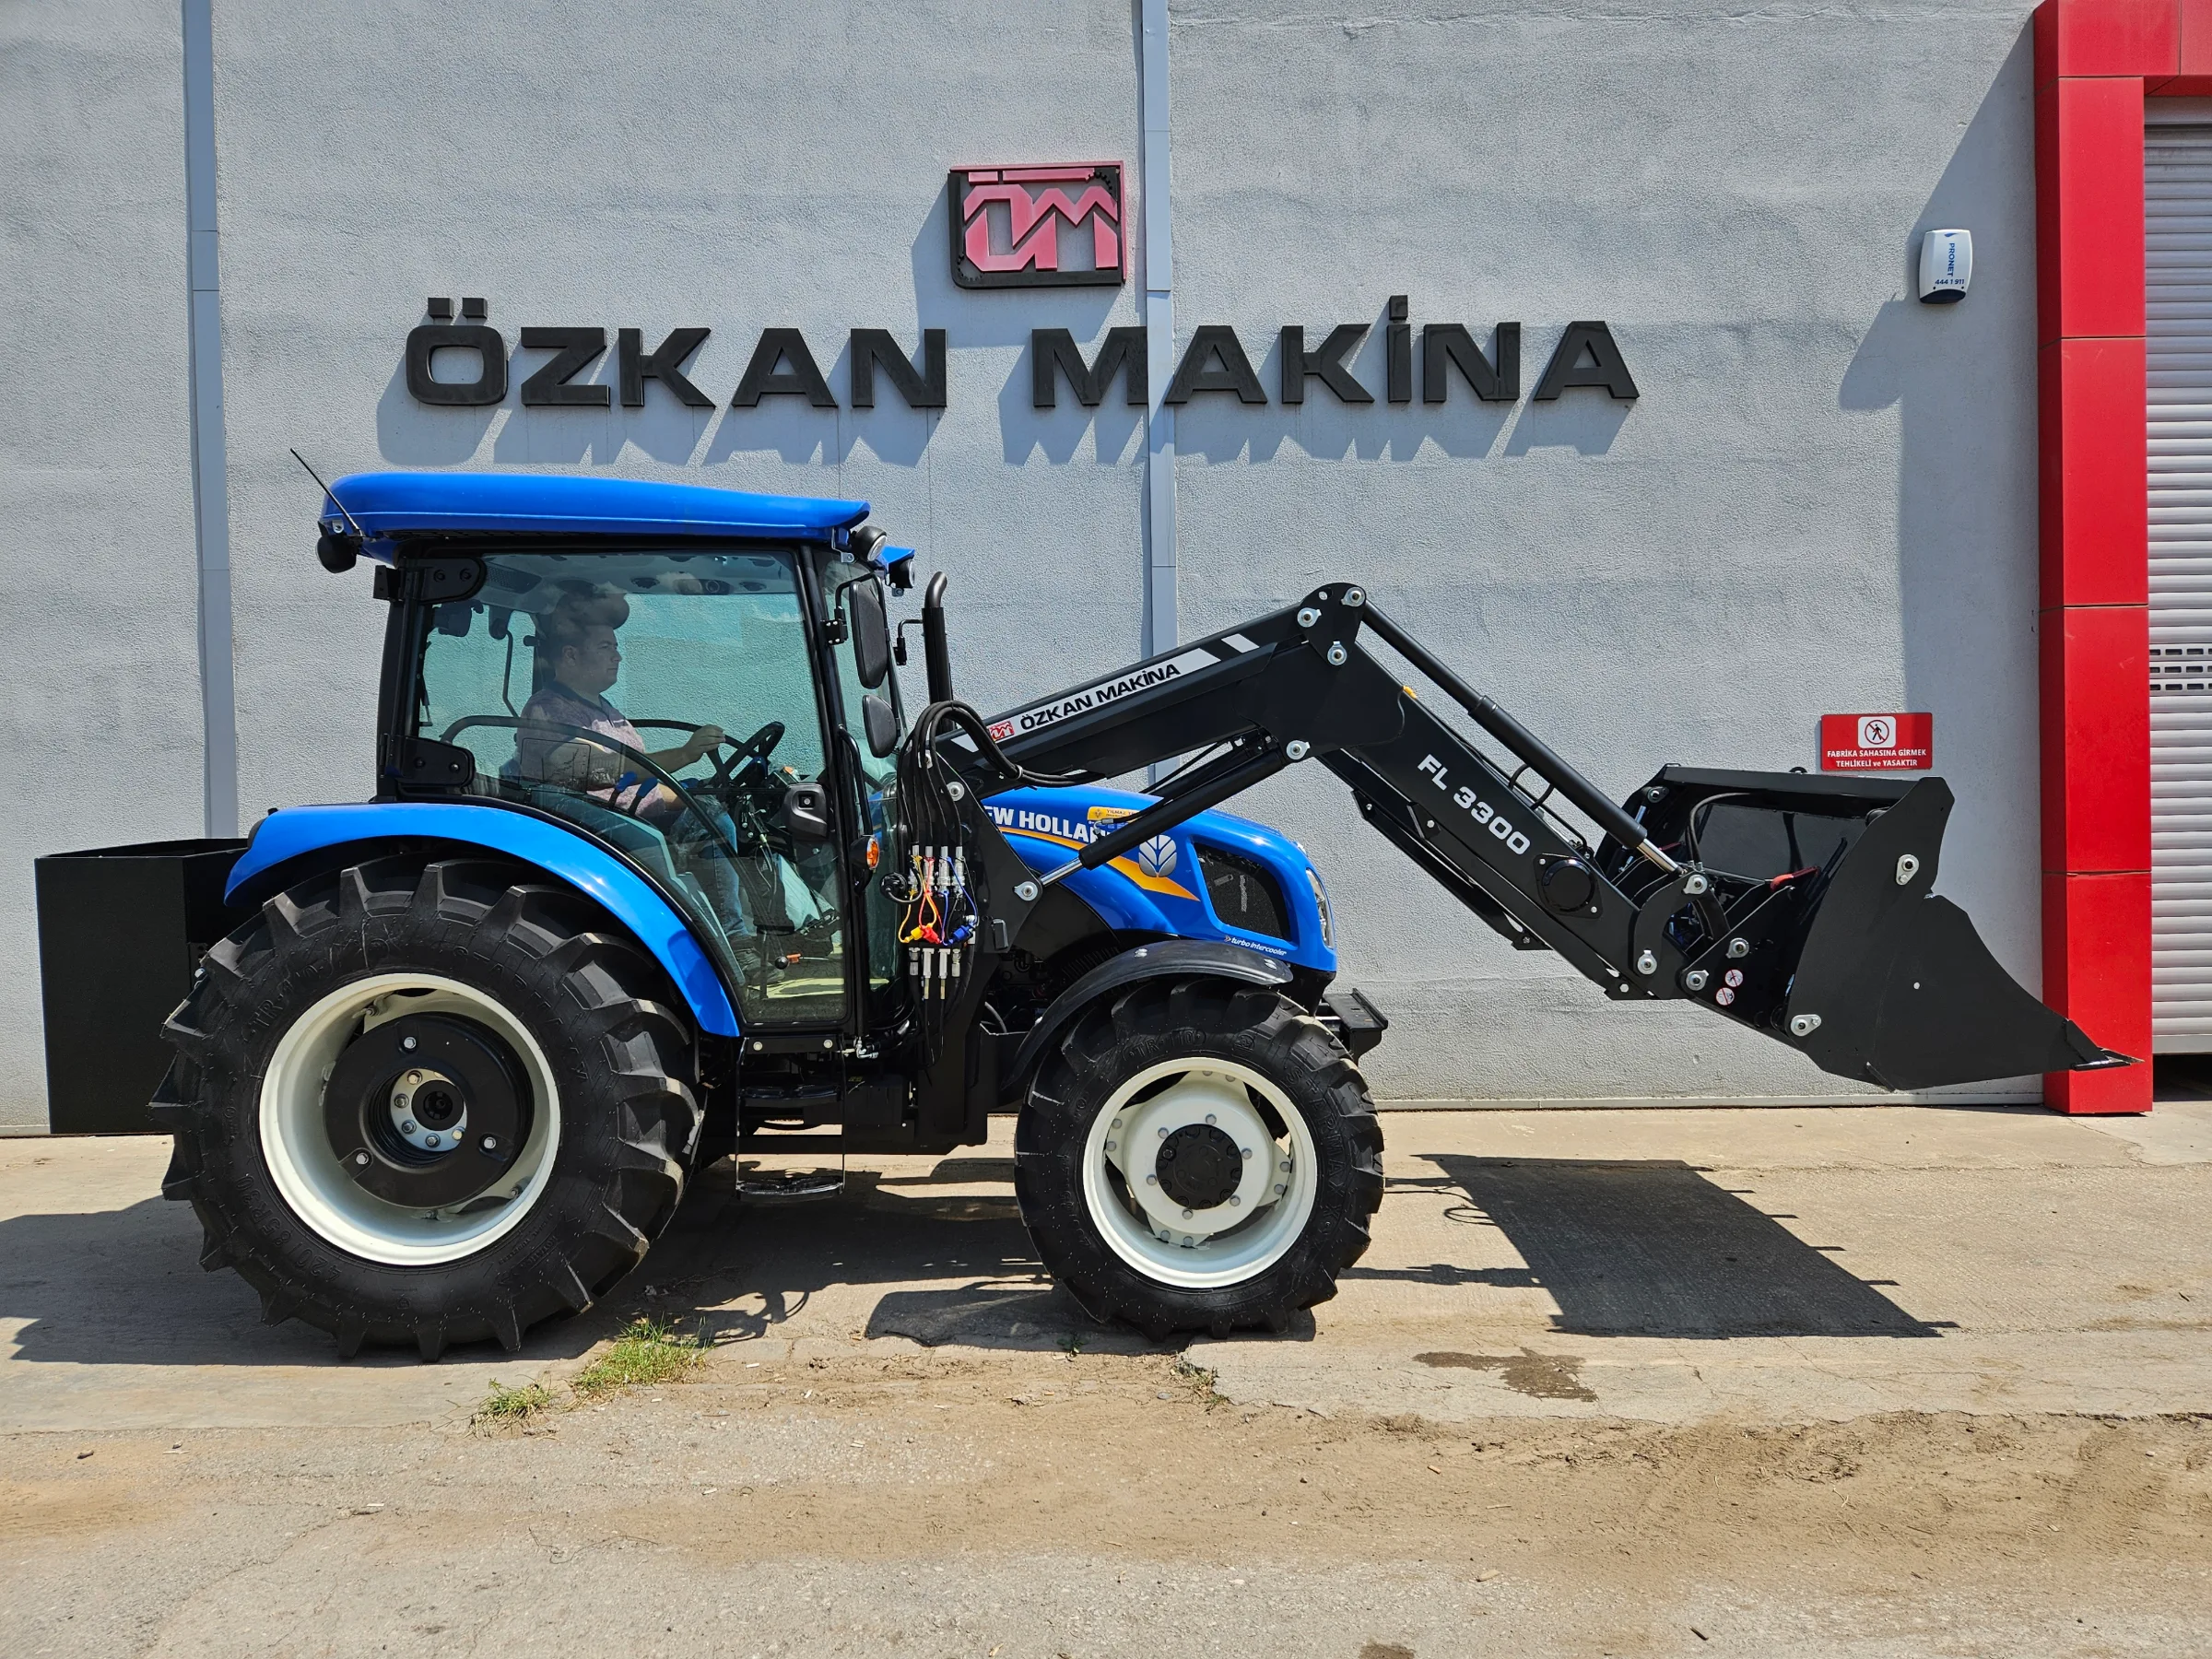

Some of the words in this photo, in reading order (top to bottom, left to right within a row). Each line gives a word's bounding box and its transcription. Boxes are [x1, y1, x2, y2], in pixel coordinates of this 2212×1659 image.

[406, 297, 947, 407] ÖZKAN
[1031, 294, 1640, 406] MAKİNA
[1020, 694, 1092, 731] ÖZKAN
[1096, 664, 1181, 703] MAKİNA
[1827, 748, 1857, 758] FABRİKA
[1898, 748, 1926, 757] GİRMEK
[1019, 810, 1111, 843] HOLLAN
[1418, 754, 1448, 791] FL
[1453, 786, 1530, 855] 3300
[1230, 937, 1251, 947] turbo
[1250, 941, 1287, 956] intercooler
[1287, 1065, 1347, 1219] STARMAXX
[234, 1175, 342, 1283] 420/85R30
